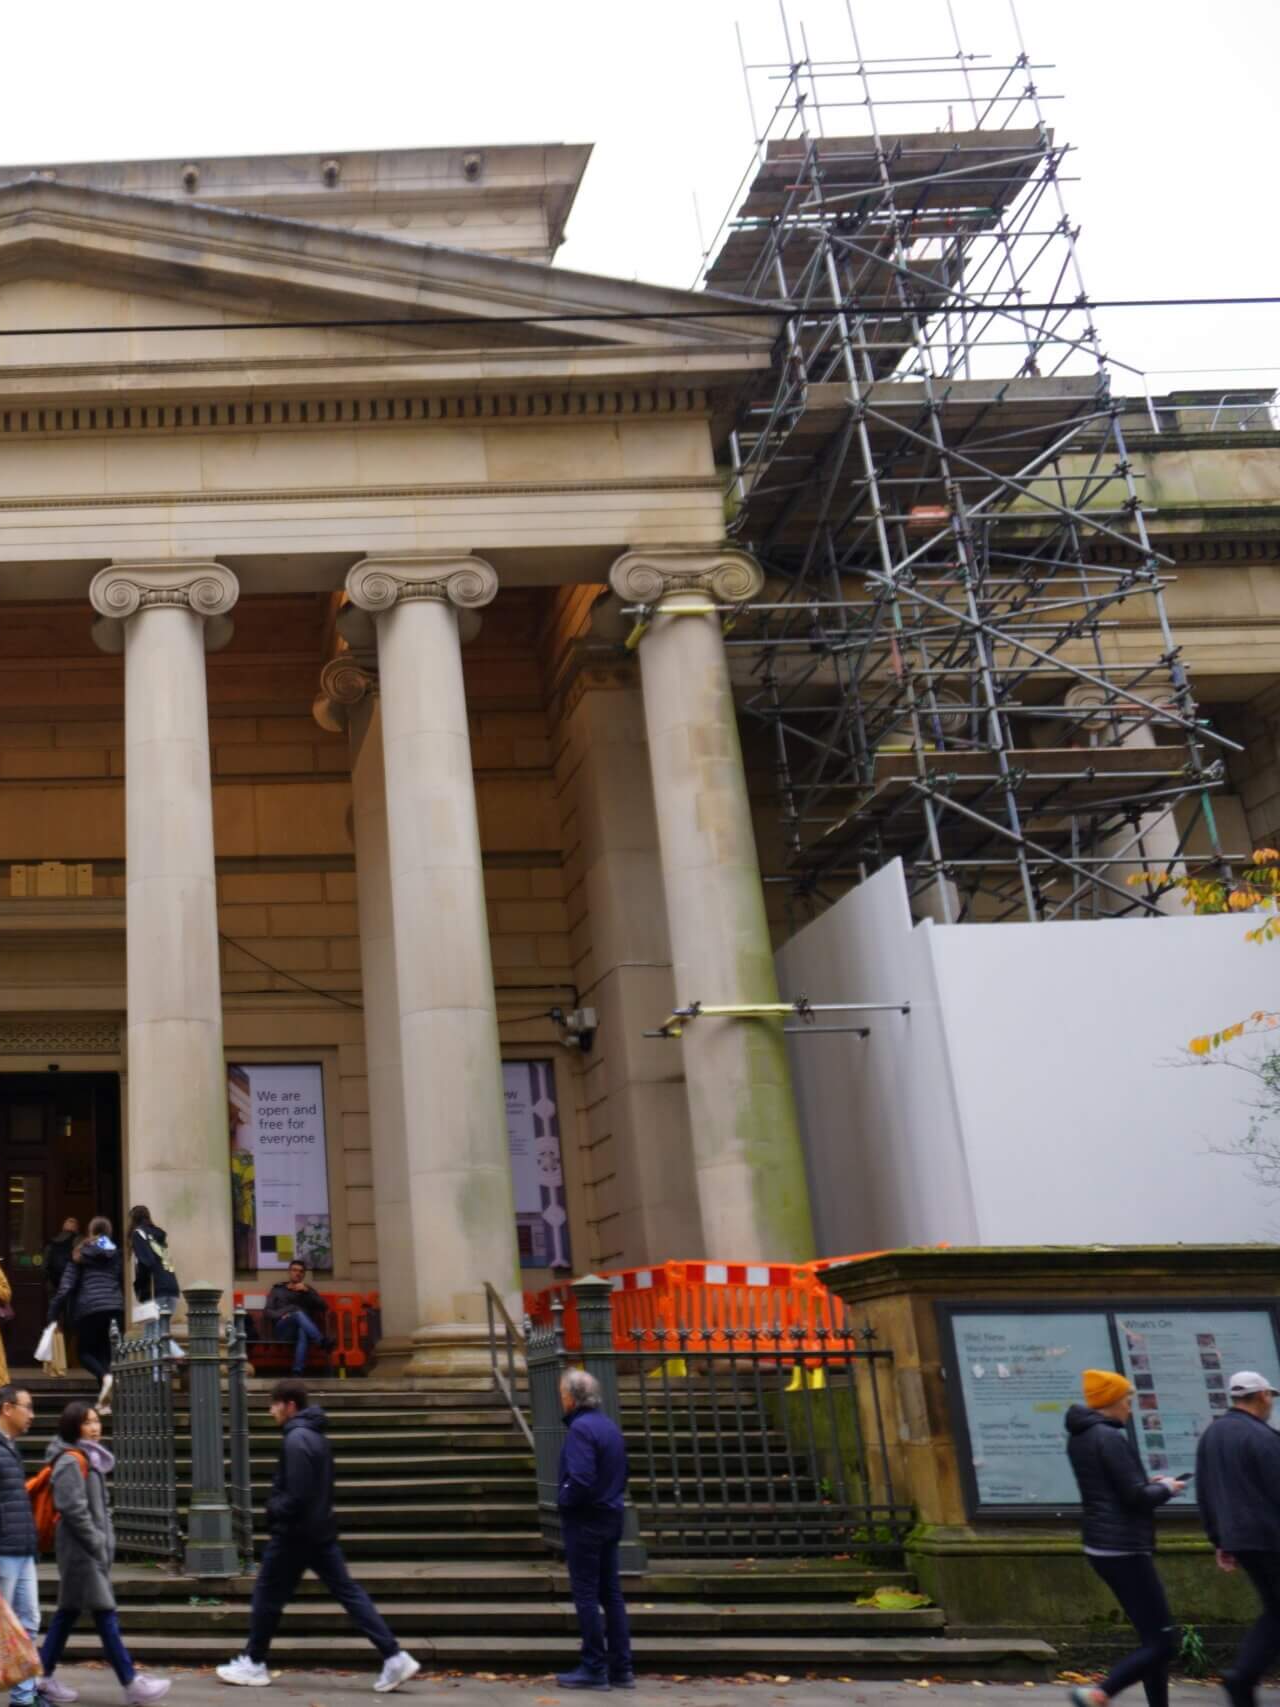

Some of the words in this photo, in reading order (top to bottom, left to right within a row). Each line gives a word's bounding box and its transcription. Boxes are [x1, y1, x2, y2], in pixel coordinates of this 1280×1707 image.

[257, 1091, 277, 1102] We
[281, 1092, 301, 1102] are
[258, 1106, 289, 1118] open
[293, 1103, 317, 1116] and
[259, 1118, 283, 1130] free
[287, 1117, 305, 1129] for
[259, 1134, 315, 1146] everyone
